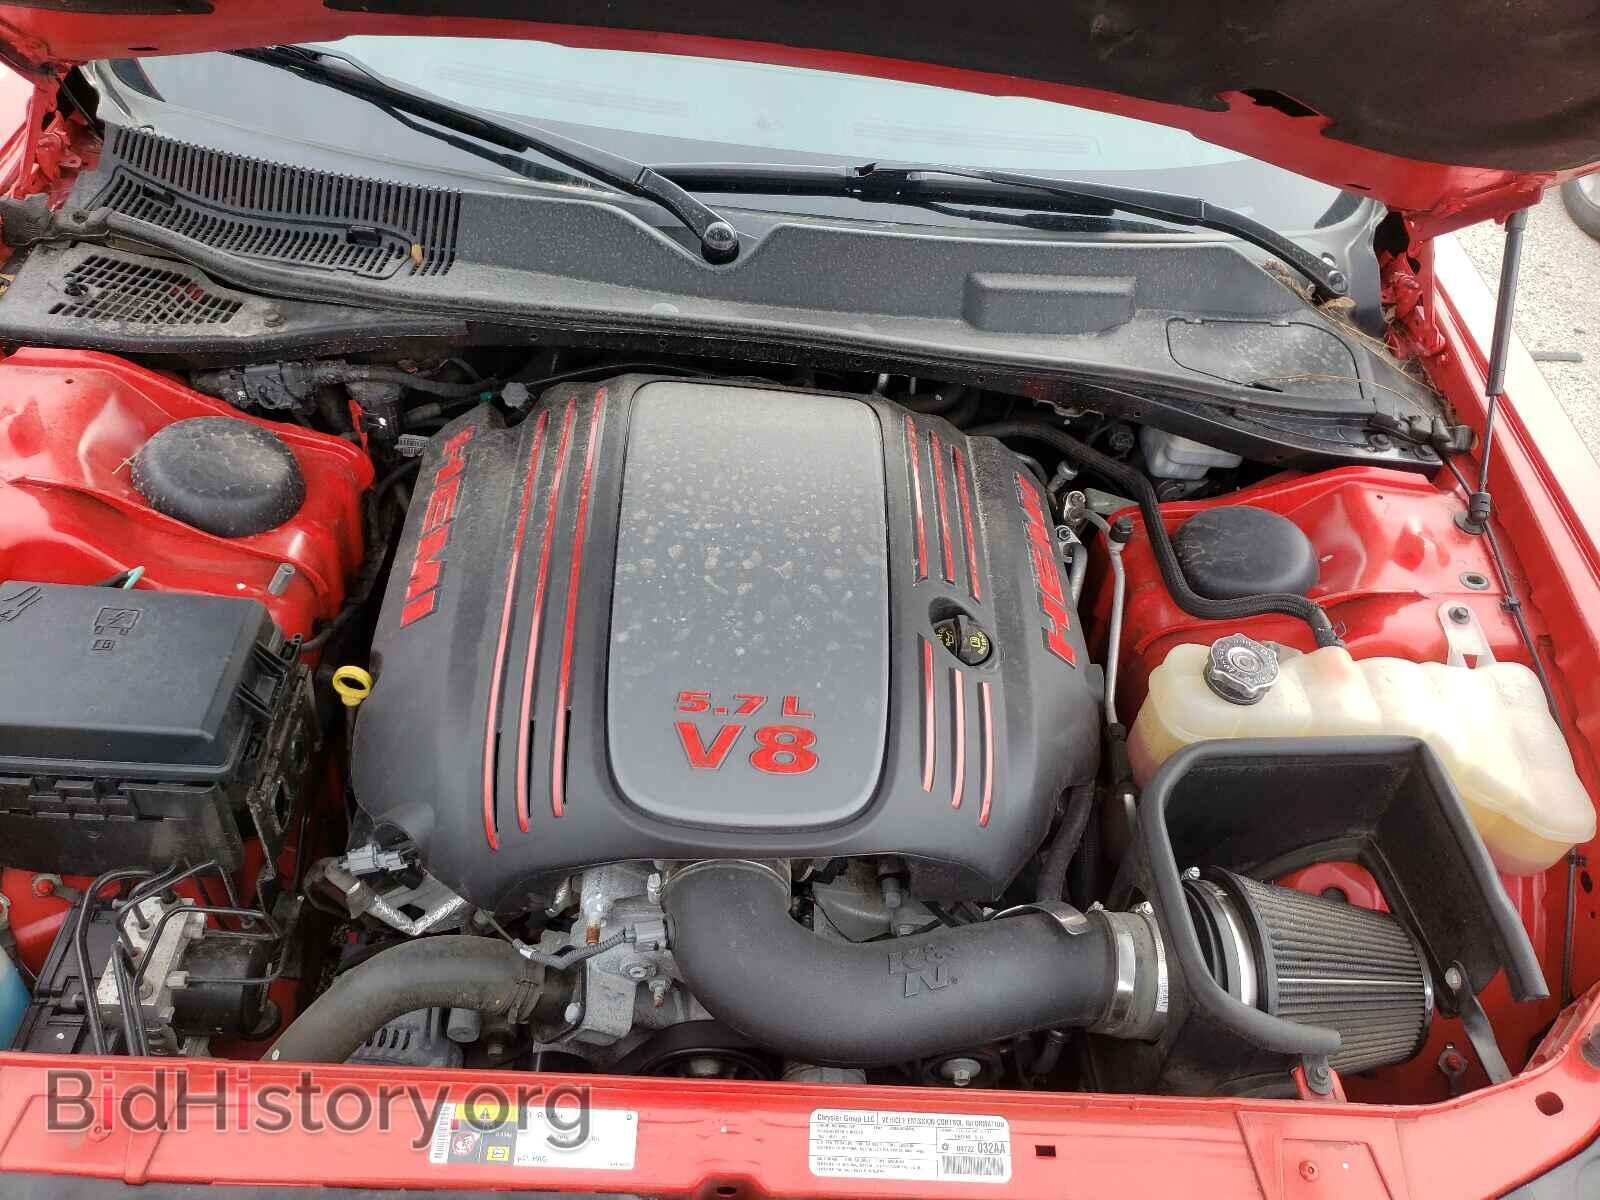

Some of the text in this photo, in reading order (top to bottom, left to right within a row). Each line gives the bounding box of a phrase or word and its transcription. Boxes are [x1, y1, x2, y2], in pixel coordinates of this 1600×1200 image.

[400, 424, 477, 629] HEMI
[1014, 471, 1078, 669] HEMI
[673, 720, 820, 775] V8
[817, 1113, 876, 1123] Chrysler Group LLC
[977, 1142, 1006, 1154] 032AA
